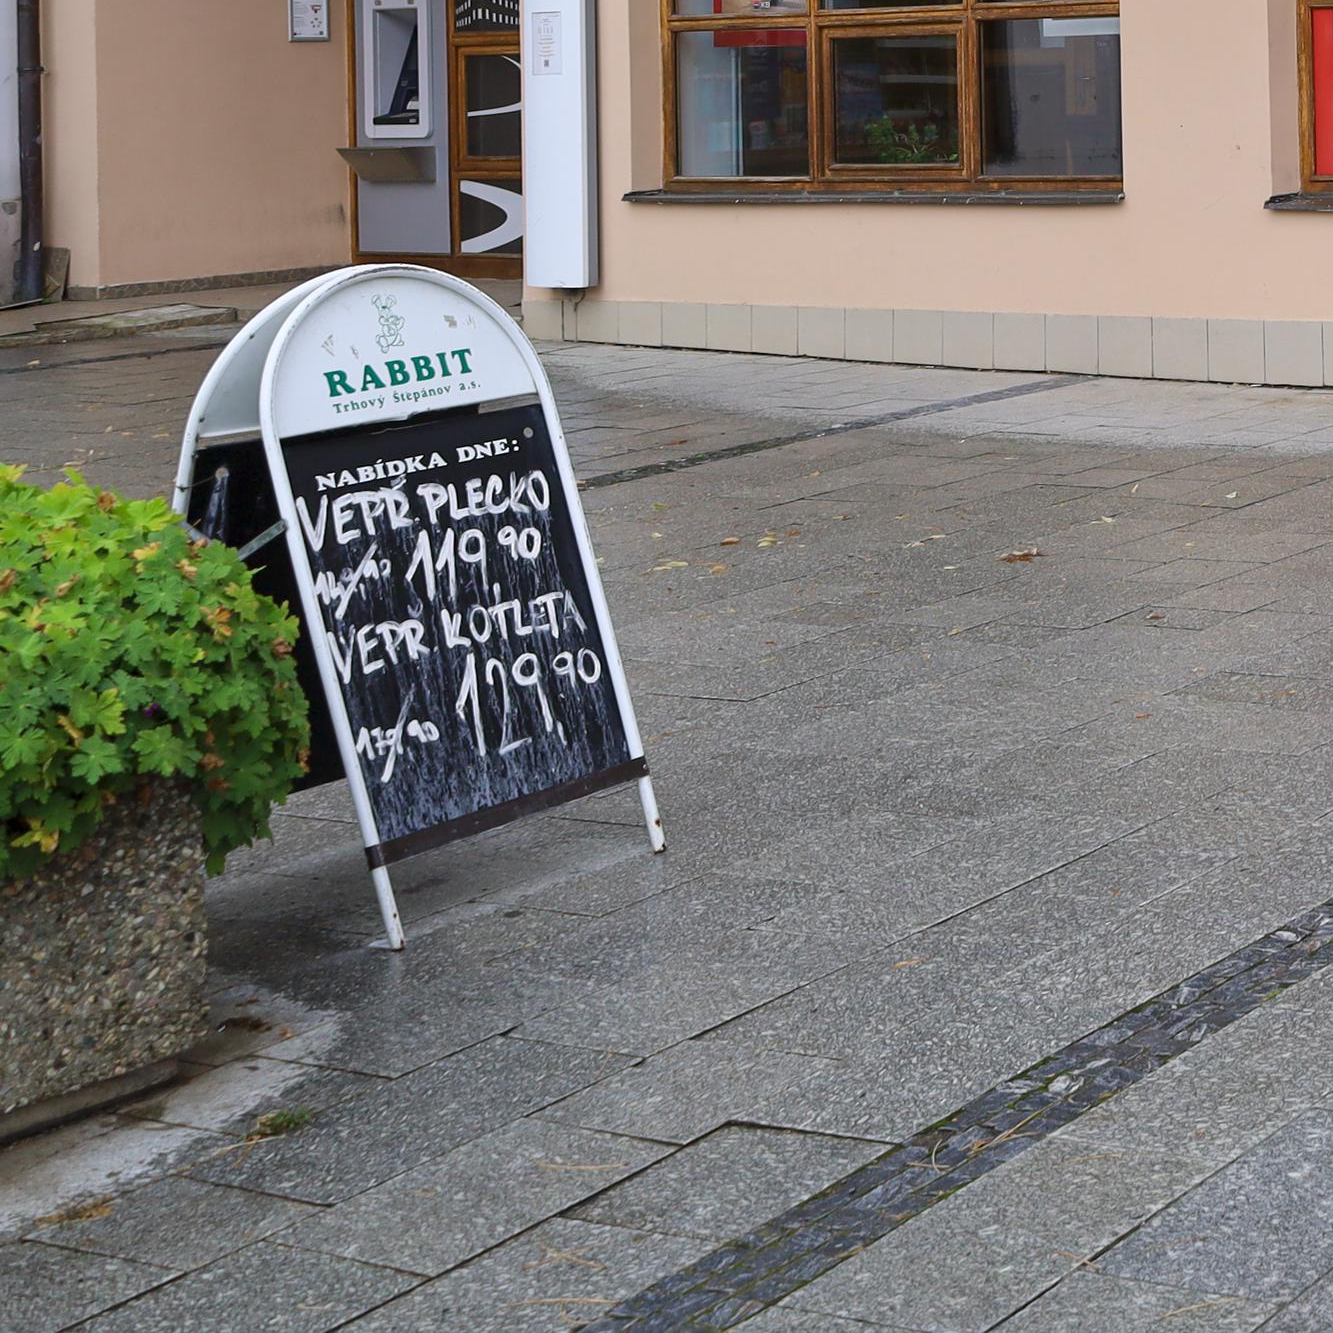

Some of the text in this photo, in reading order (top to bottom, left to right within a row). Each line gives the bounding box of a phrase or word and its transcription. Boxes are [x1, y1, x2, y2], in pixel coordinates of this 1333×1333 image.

[323, 348, 472, 398] RABBIT
[333, 396, 386, 414] Trhový
[459, 382, 481, 391] a.s.
[315, 439, 519, 491] NABÍDKA DNE:
[416, 469, 549, 524] PLECKO
[440, 589, 588, 649] KOTLETA
